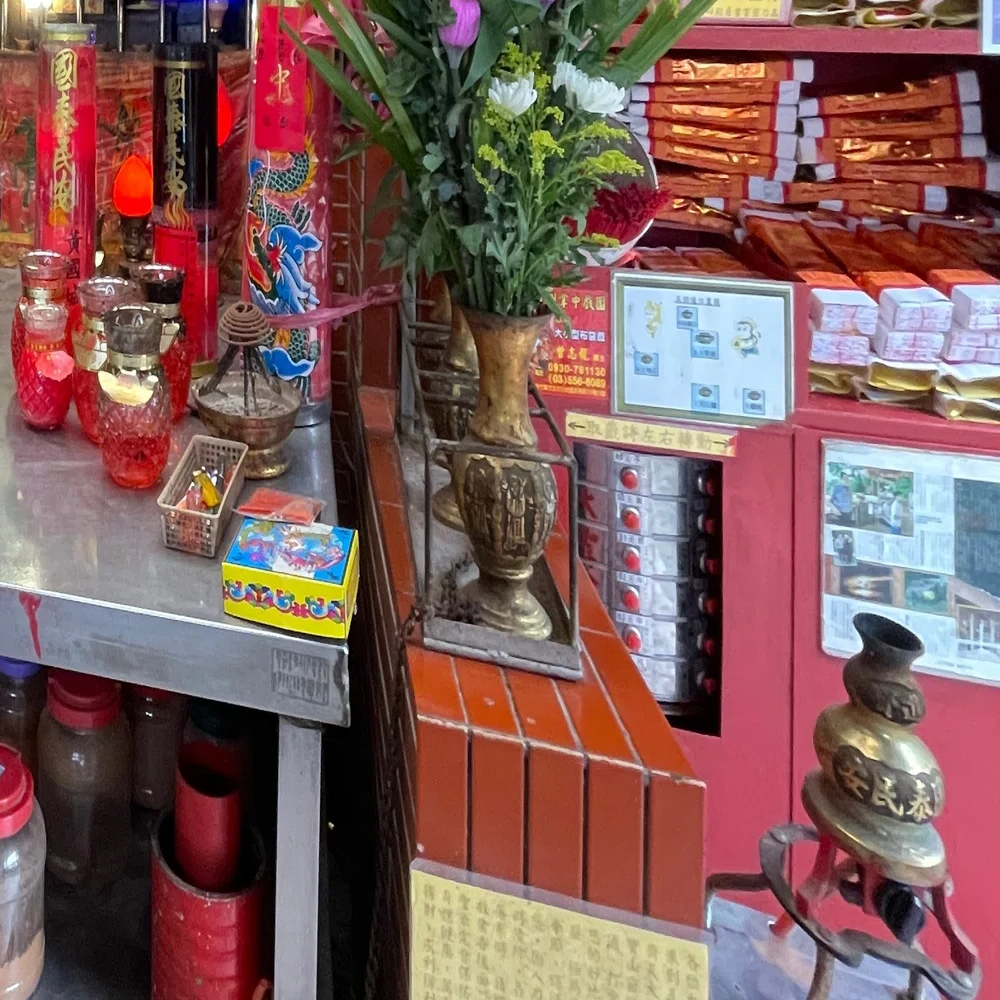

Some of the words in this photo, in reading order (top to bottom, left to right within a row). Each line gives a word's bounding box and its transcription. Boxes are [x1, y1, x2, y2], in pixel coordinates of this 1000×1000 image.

[51, 48, 79, 213] 國泰民安
[163, 70, 189, 198] 國泰民安
